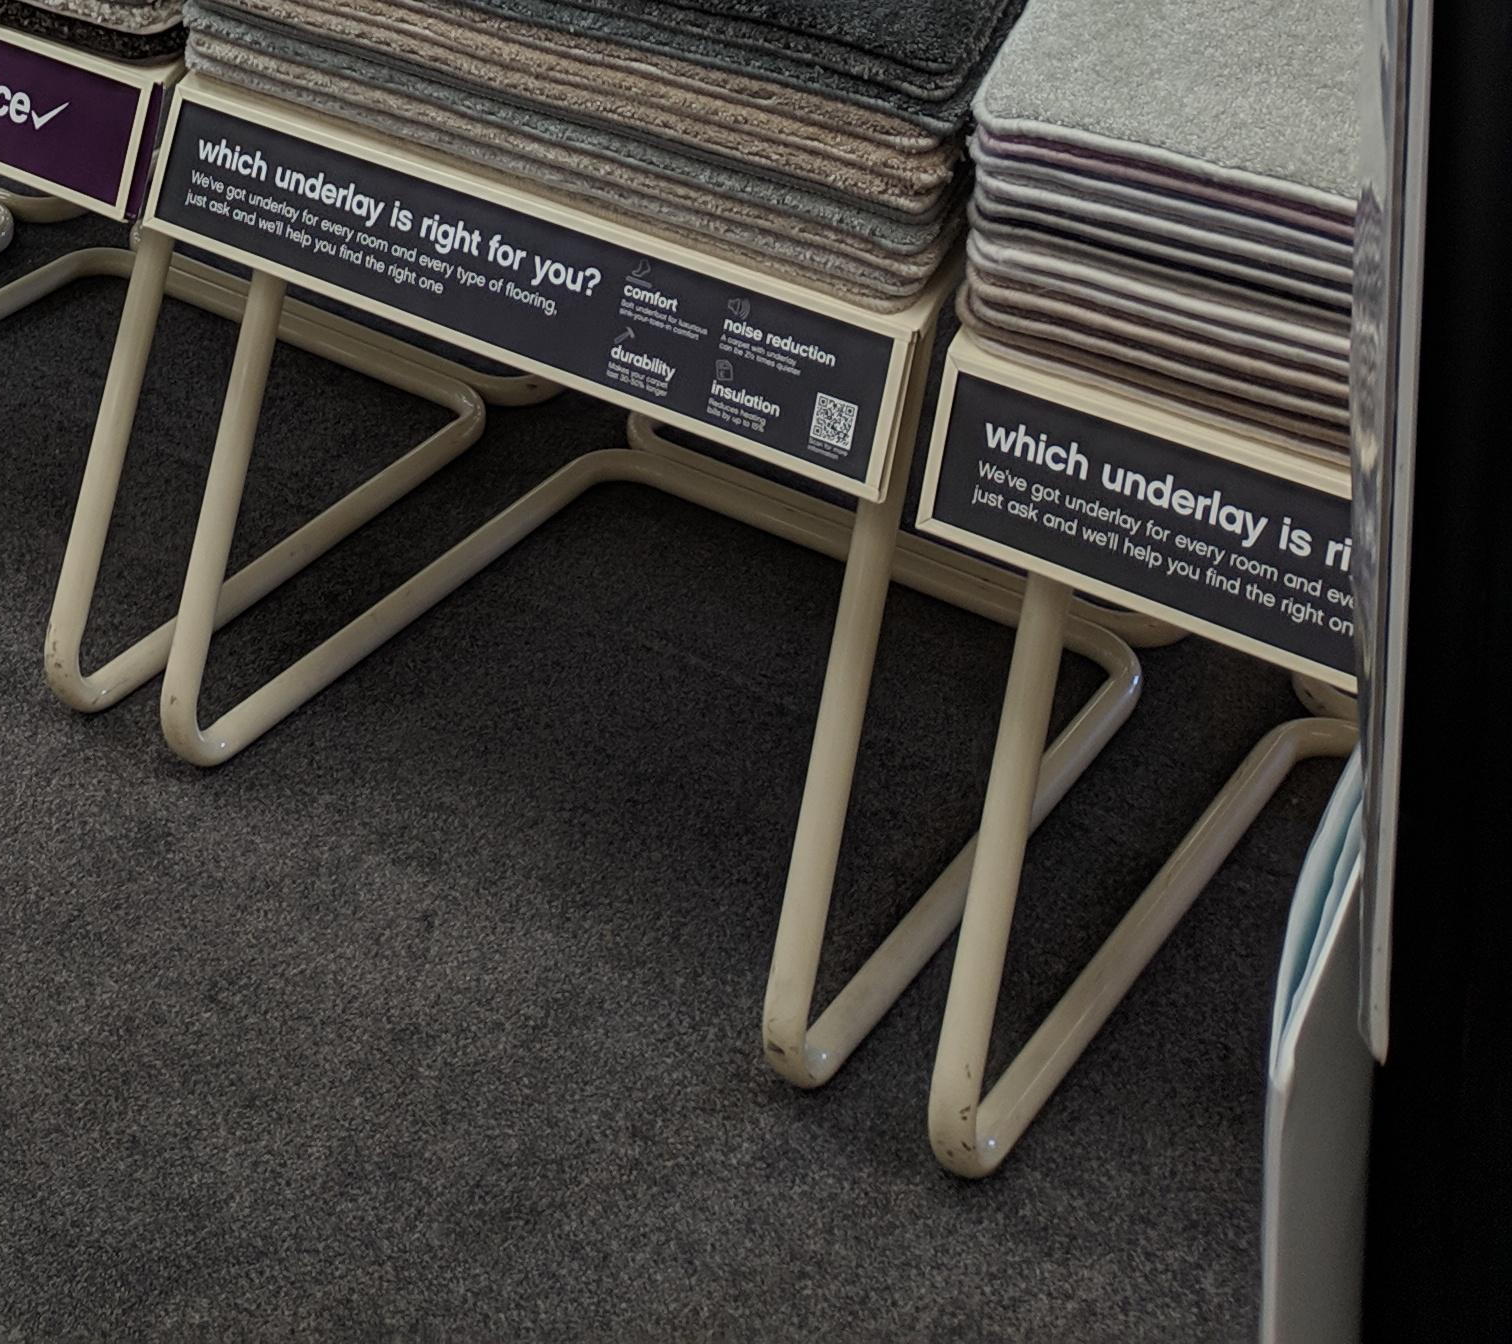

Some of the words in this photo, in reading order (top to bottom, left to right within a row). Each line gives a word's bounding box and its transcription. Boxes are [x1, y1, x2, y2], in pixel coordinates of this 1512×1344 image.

[185, 188, 208, 208] just
[208, 198, 230, 217] ask
[232, 208, 257, 226] and
[285, 224, 313, 249] help
[313, 237, 337, 256] you
[338, 242, 363, 265] find
[364, 254, 386, 274] the
[387, 262, 417, 285] right
[418, 275, 444, 295] one
[198, 138, 268, 182] which
[274, 165, 386, 228] underlay
[389, 200, 414, 232] is
[419, 213, 482, 255] right
[487, 233, 527, 271] for
[530, 254, 602, 297] you?
[226, 184, 247, 202] got
[248, 193, 300, 223] underlay
[301, 208, 319, 227] for
[320, 220, 356, 243] every
[355, 231, 389, 253] room
[391, 243, 418, 263] and
[418, 253, 455, 279] every
[456, 265, 487, 288] type
[488, 278, 504, 294] of
[623, 284, 679, 313] comfort
[722, 317, 764, 342] noise
[765, 332, 836, 368] reduction
[610, 344, 677, 382] durability
[710, 379, 781, 418] insulation
[978, 460, 1028, 492] We've
[1030, 483, 1061, 505] got
[1064, 493, 1142, 536] underlay
[1145, 519, 1171, 543] for
[1174, 533, 1226, 566] every
[1229, 553, 1279, 583] room
[1283, 572, 1323, 598] and
[985, 422, 1089, 481] which
[1101, 463, 1269, 549] underlay
[1278, 515, 1313, 558] is
[971, 484, 1005, 511] just
[1007, 500, 1039, 522] ask
[1042, 512, 1078, 536] and
[1122, 536, 1164, 569] help
[1166, 556, 1201, 582] you
[1205, 566, 1242, 596] find
[1245, 582, 1276, 609] the
[1280, 596, 1325, 626] right
